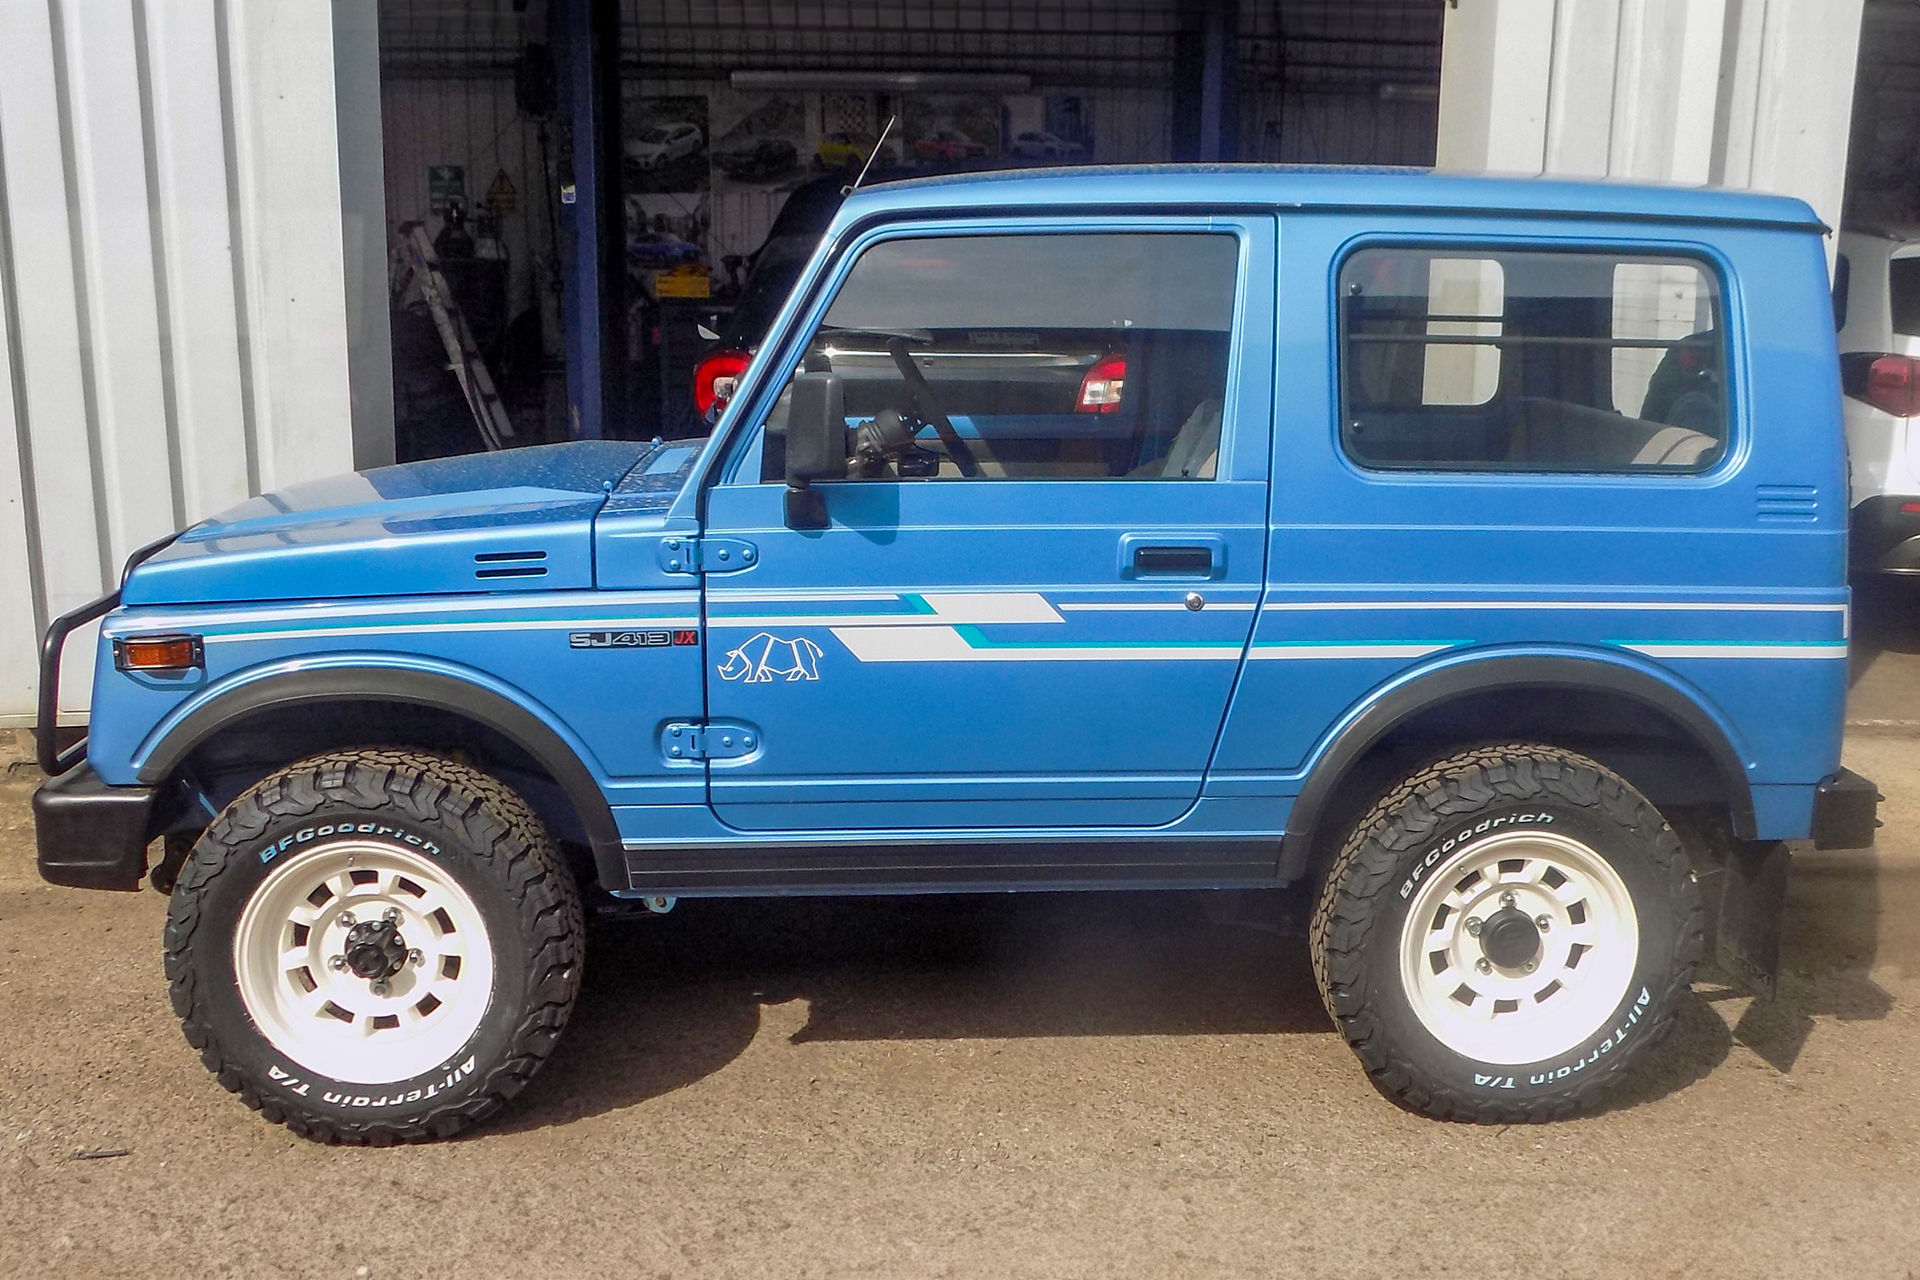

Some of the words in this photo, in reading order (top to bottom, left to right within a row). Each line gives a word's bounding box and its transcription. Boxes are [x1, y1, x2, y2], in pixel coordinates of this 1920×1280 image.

[570, 632, 671, 647] SJ413
[673, 631, 696, 645] JX
[258, 822, 441, 864] BFGoodrich
[1399, 812, 1554, 899] BFGoodrich
[1529, 986, 1651, 1084] All-Terrain
[267, 1065, 311, 1097] T/A
[322, 1055, 475, 1108] All-Terrain
[1474, 1073, 1515, 1089] T/A
